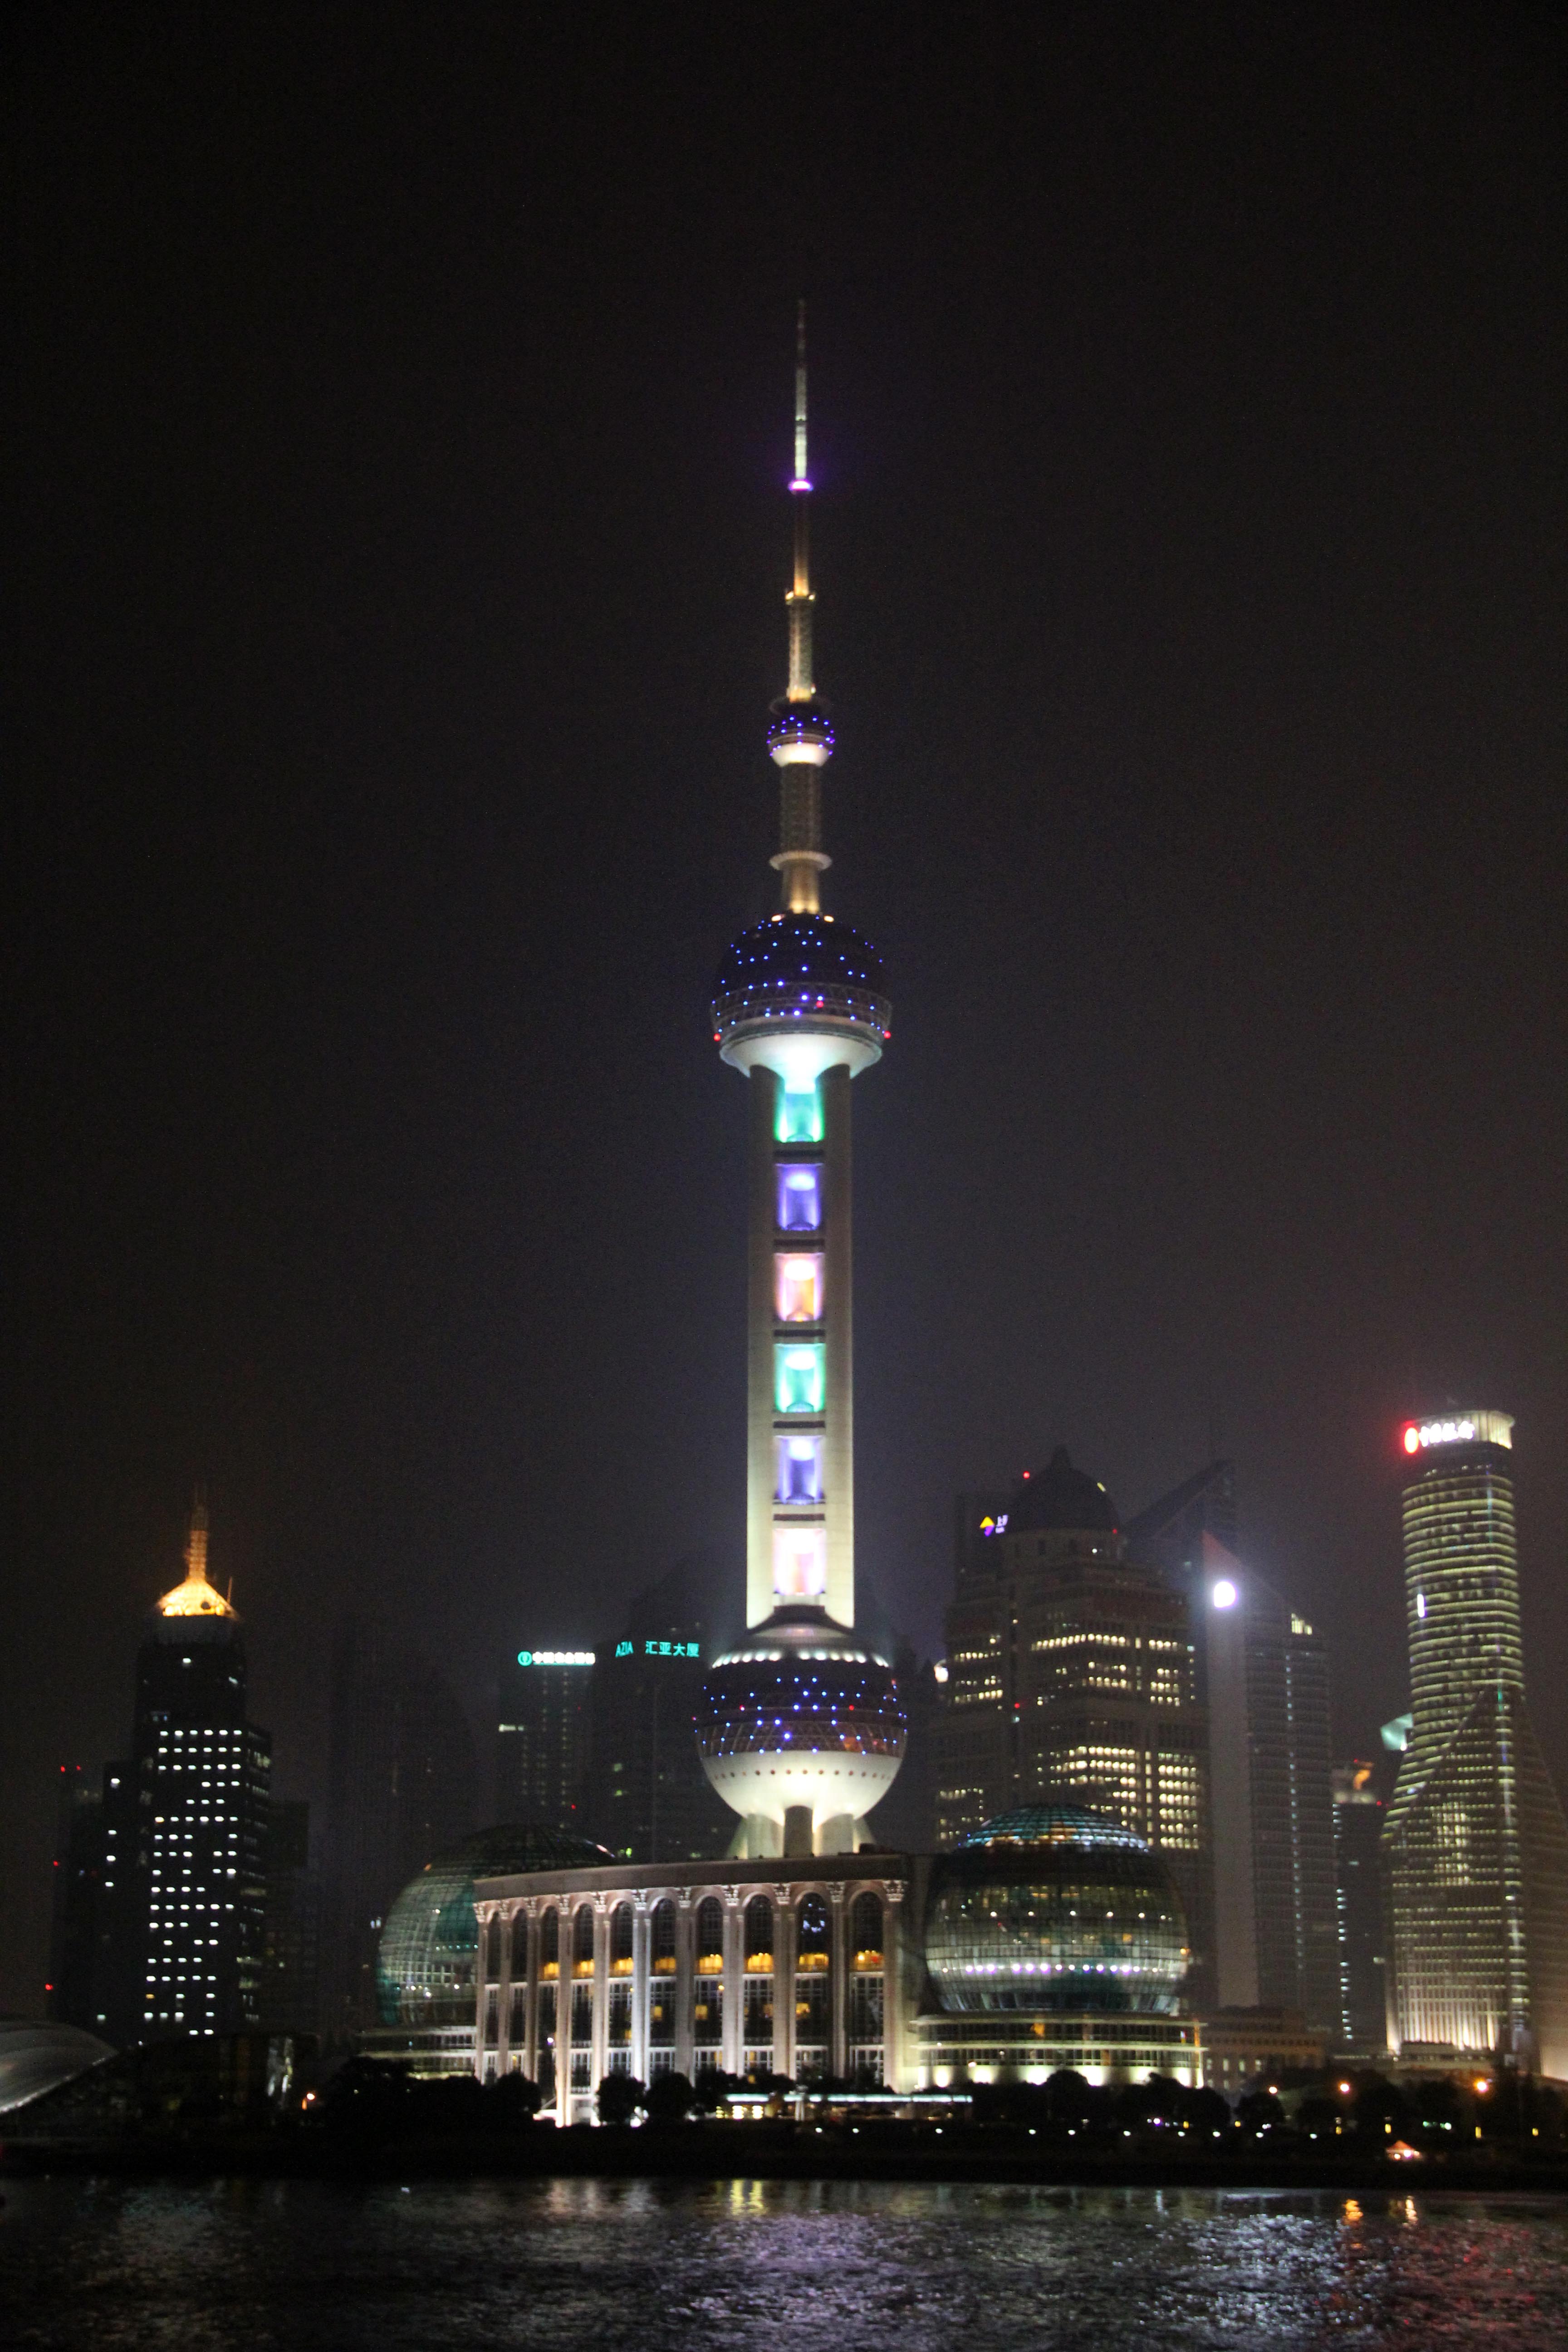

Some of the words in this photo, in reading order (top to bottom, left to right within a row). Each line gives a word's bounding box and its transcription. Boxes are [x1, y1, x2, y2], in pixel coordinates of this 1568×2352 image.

[615, 1641, 633, 1657] AZIA
[645, 1641, 700, 1657] 汇亚大厦
